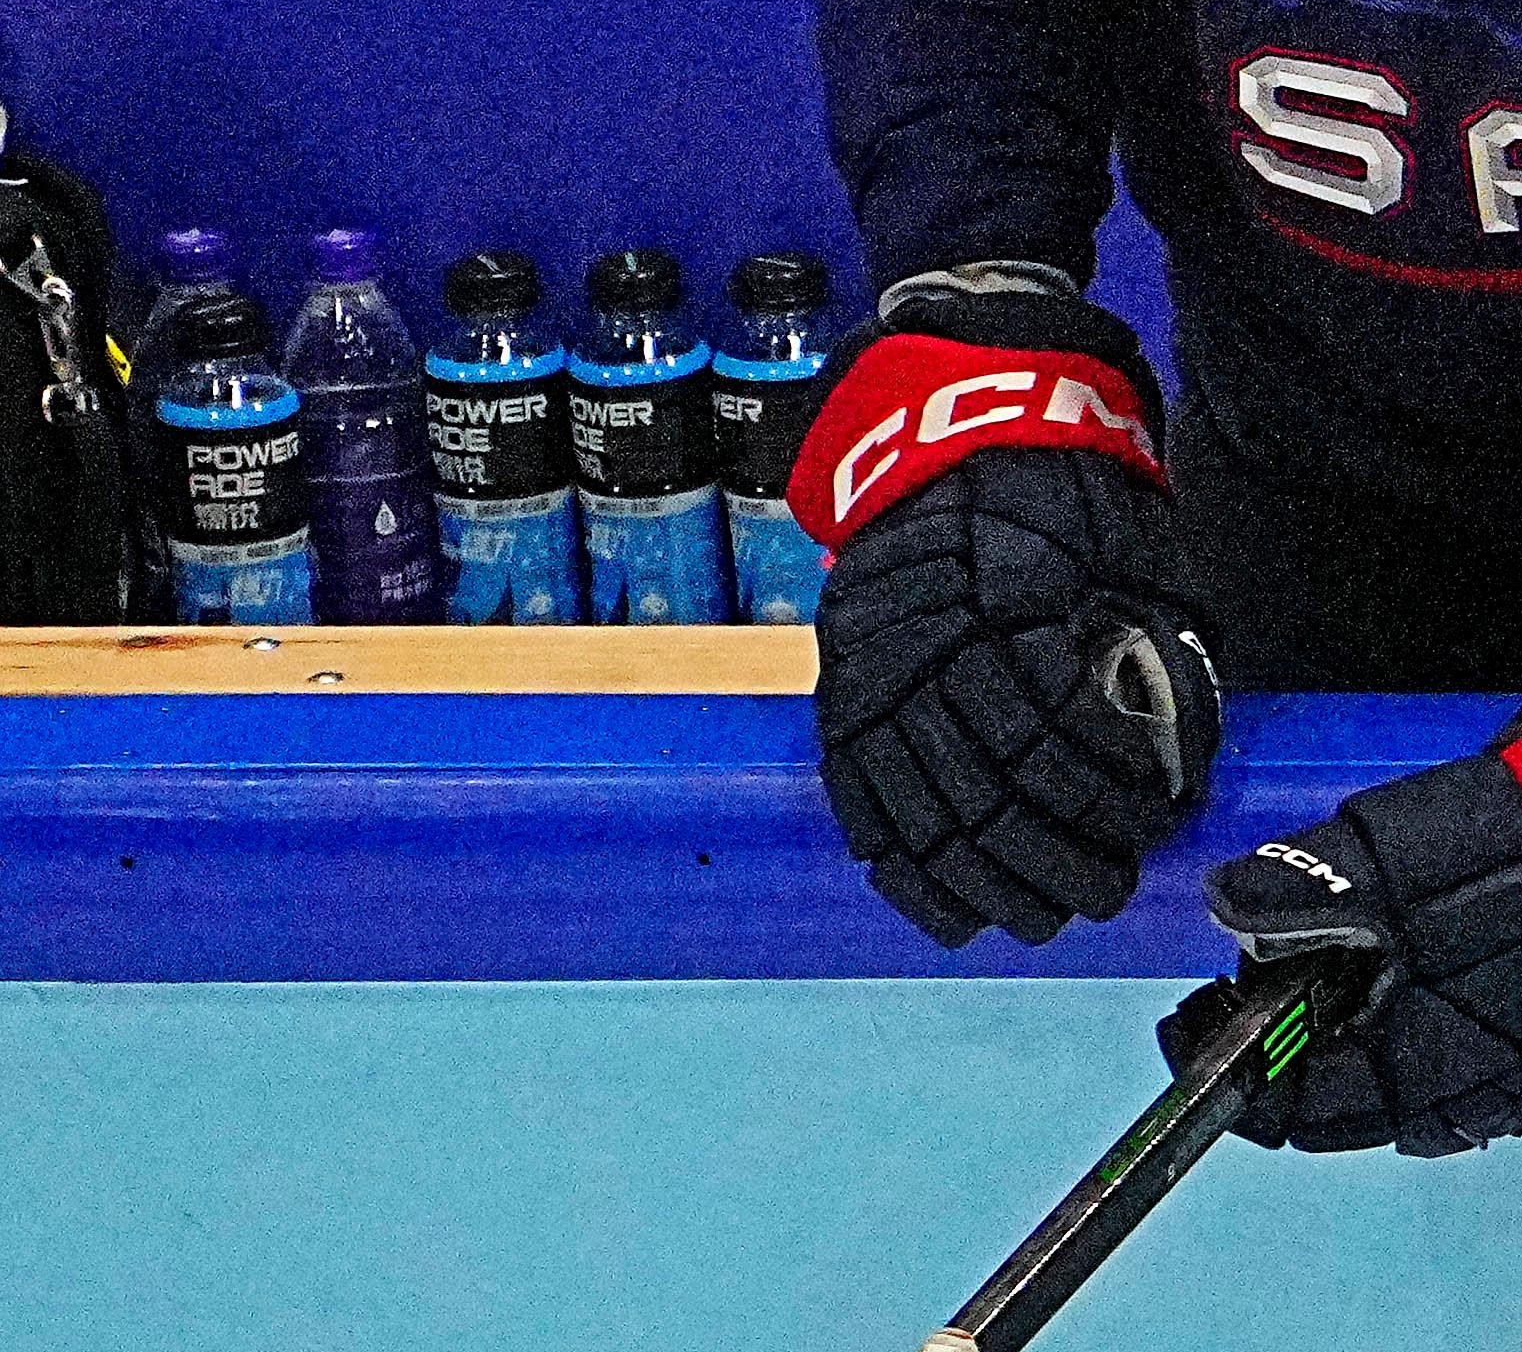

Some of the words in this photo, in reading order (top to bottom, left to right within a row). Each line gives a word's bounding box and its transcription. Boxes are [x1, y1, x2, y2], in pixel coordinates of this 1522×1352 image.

[569, 395, 655, 427] OWER
[187, 431, 299, 470] POWER
[189, 472, 266, 497] ADE
[1256, 843, 1352, 894] CCM
